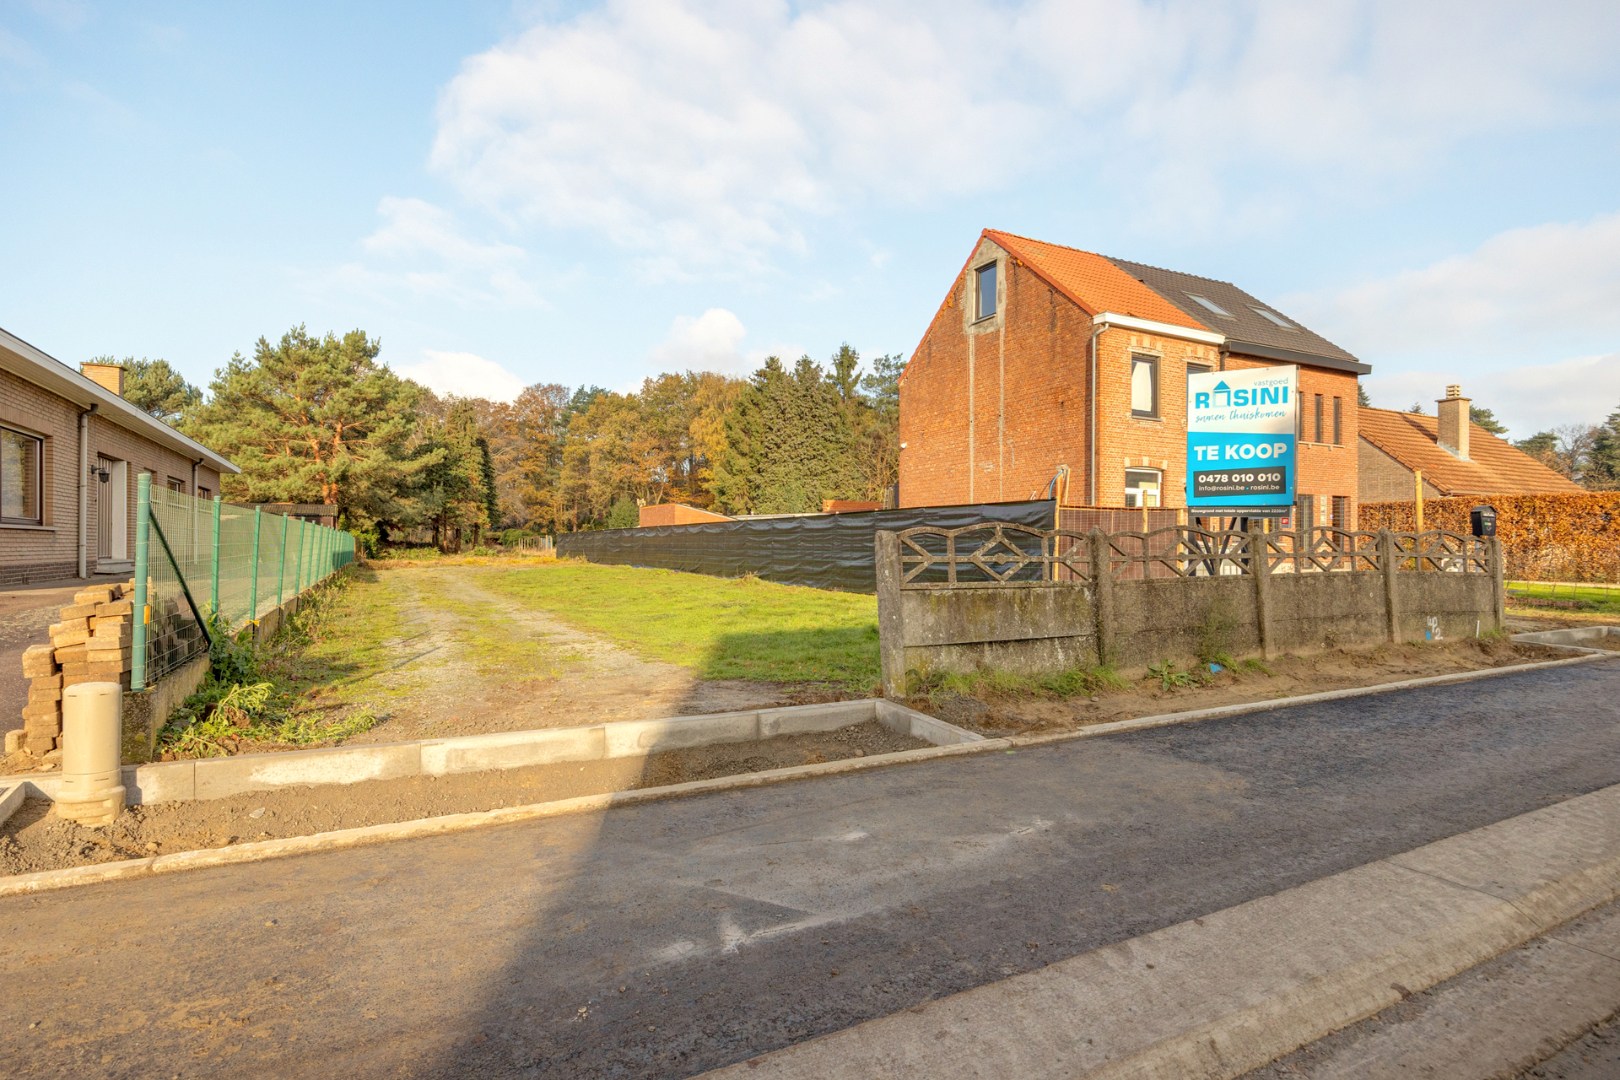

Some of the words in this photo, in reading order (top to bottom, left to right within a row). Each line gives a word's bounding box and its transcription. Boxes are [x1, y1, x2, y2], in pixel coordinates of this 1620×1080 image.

[1254, 377, 1289, 387] vastgoed
[1195, 413, 1226, 423] samen
[1230, 407, 1286, 420] thuiskomen
[1193, 445, 1220, 461] TE
[1225, 442, 1287, 460] KOOP
[1198, 474, 1229, 483] 0478
[1231, 473, 1254, 483] 010
[1257, 472, 1281, 482] 010
